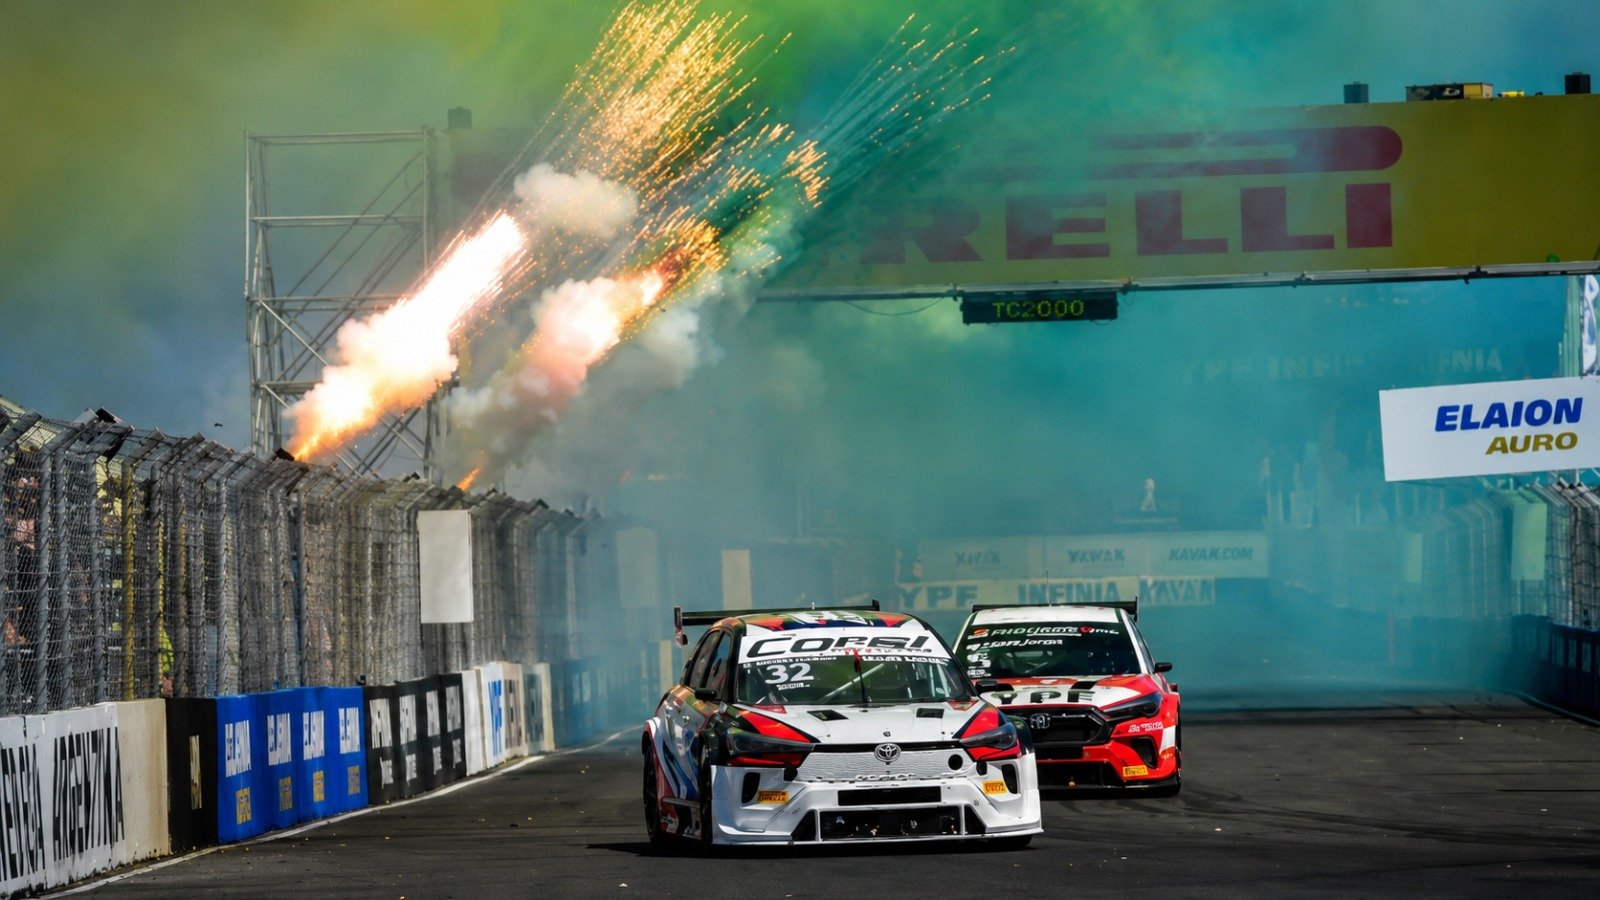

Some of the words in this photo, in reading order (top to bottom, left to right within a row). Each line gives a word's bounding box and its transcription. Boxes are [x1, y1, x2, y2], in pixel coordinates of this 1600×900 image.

[993, 300, 1086, 318] TC2000
[1435, 397, 1583, 432] ELAION
[1486, 432, 1579, 455] AURO
[1168, 547, 1254, 563] KAVAK.COM
[765, 661, 815, 684] 32
